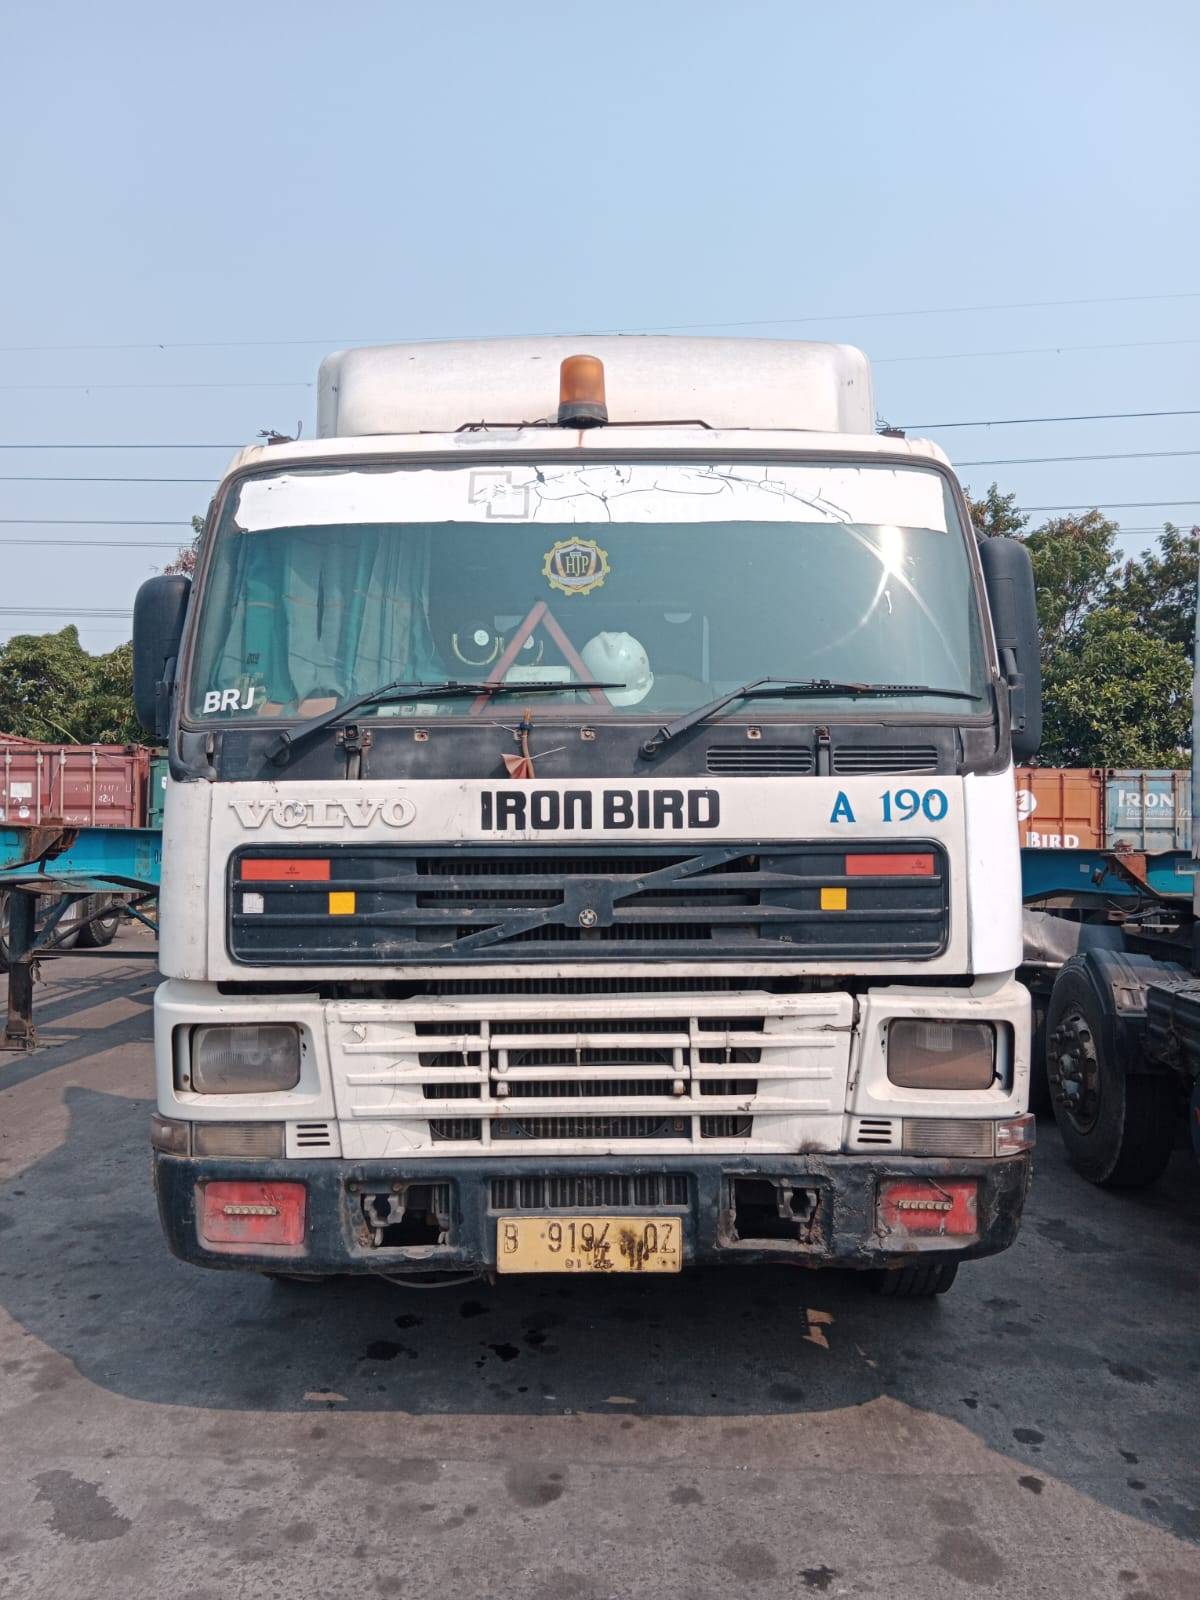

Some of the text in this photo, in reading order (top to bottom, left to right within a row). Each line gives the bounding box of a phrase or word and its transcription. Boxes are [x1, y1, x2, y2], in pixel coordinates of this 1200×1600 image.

[203, 687, 255, 713] BRJ
[481, 789, 720, 830] IRON BIRD
[830, 788, 949, 823] A 190
[1118, 789, 1175, 808] IRON
[229, 799, 416, 828] VOLVO
[1026, 831, 1080, 848] BIRD
[503, 1223, 518, 1253] B
[548, 1222, 610, 1253] 9194
